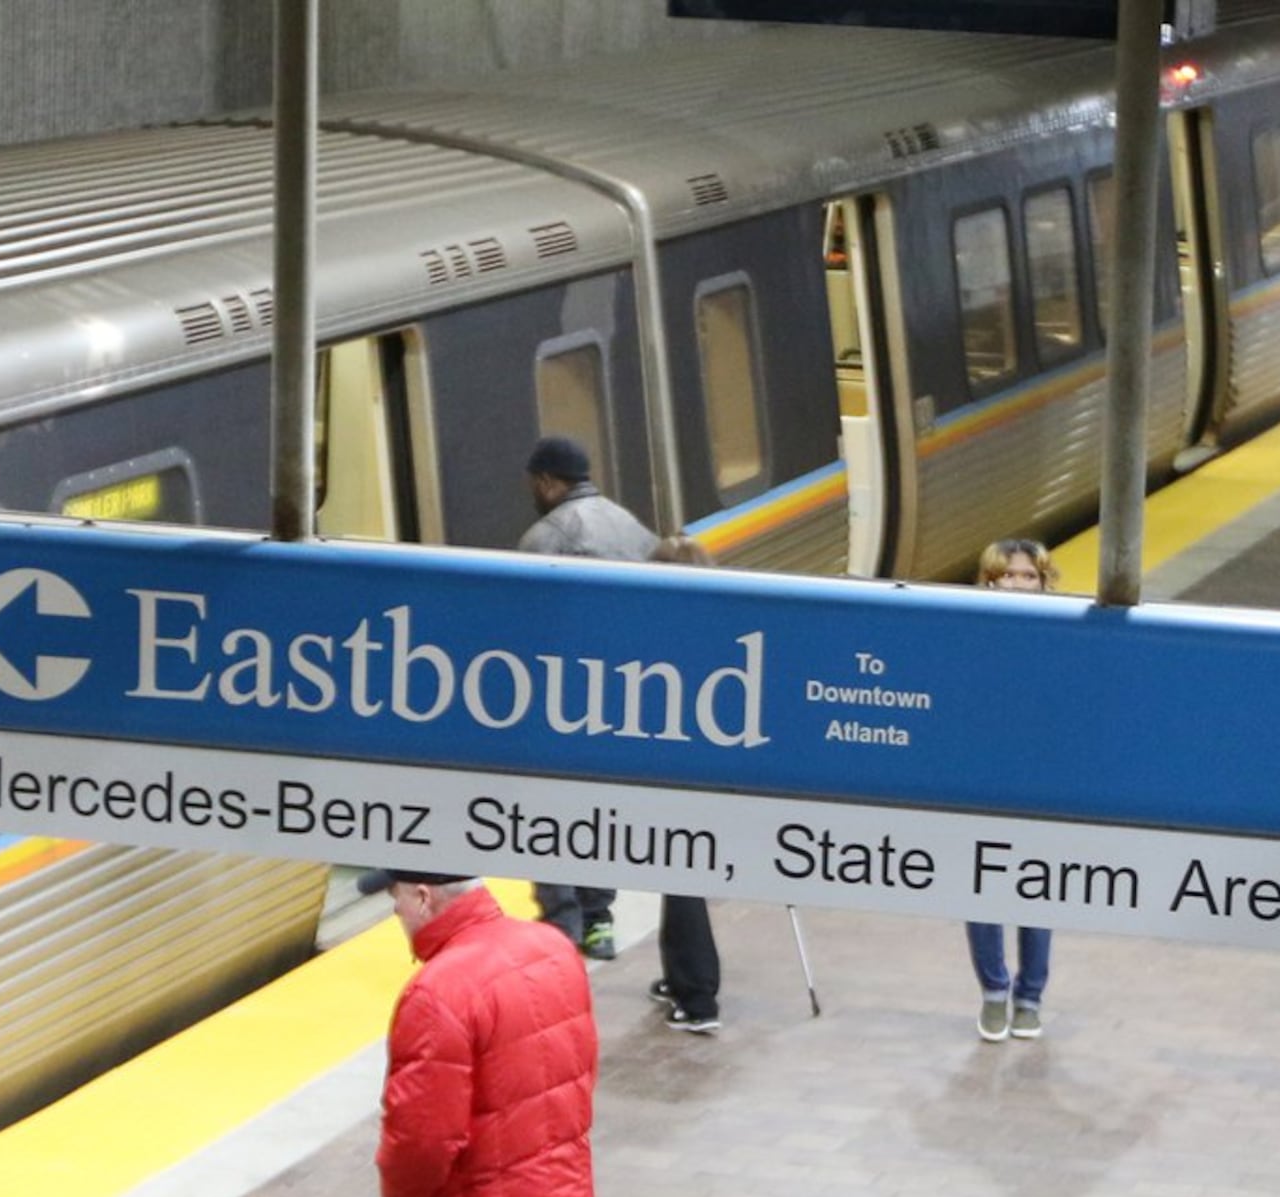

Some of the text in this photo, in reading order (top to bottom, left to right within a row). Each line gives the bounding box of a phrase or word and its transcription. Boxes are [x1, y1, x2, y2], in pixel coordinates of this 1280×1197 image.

[124, 588, 771, 749] Eastbound
[854, 652, 885, 675] To
[806, 680, 931, 709] Downtown
[825, 719, 910, 747] Atlanta
[465, 797, 734, 880] Stadium,
[774, 823, 934, 890] State
[973, 840, 1138, 908] Farm
